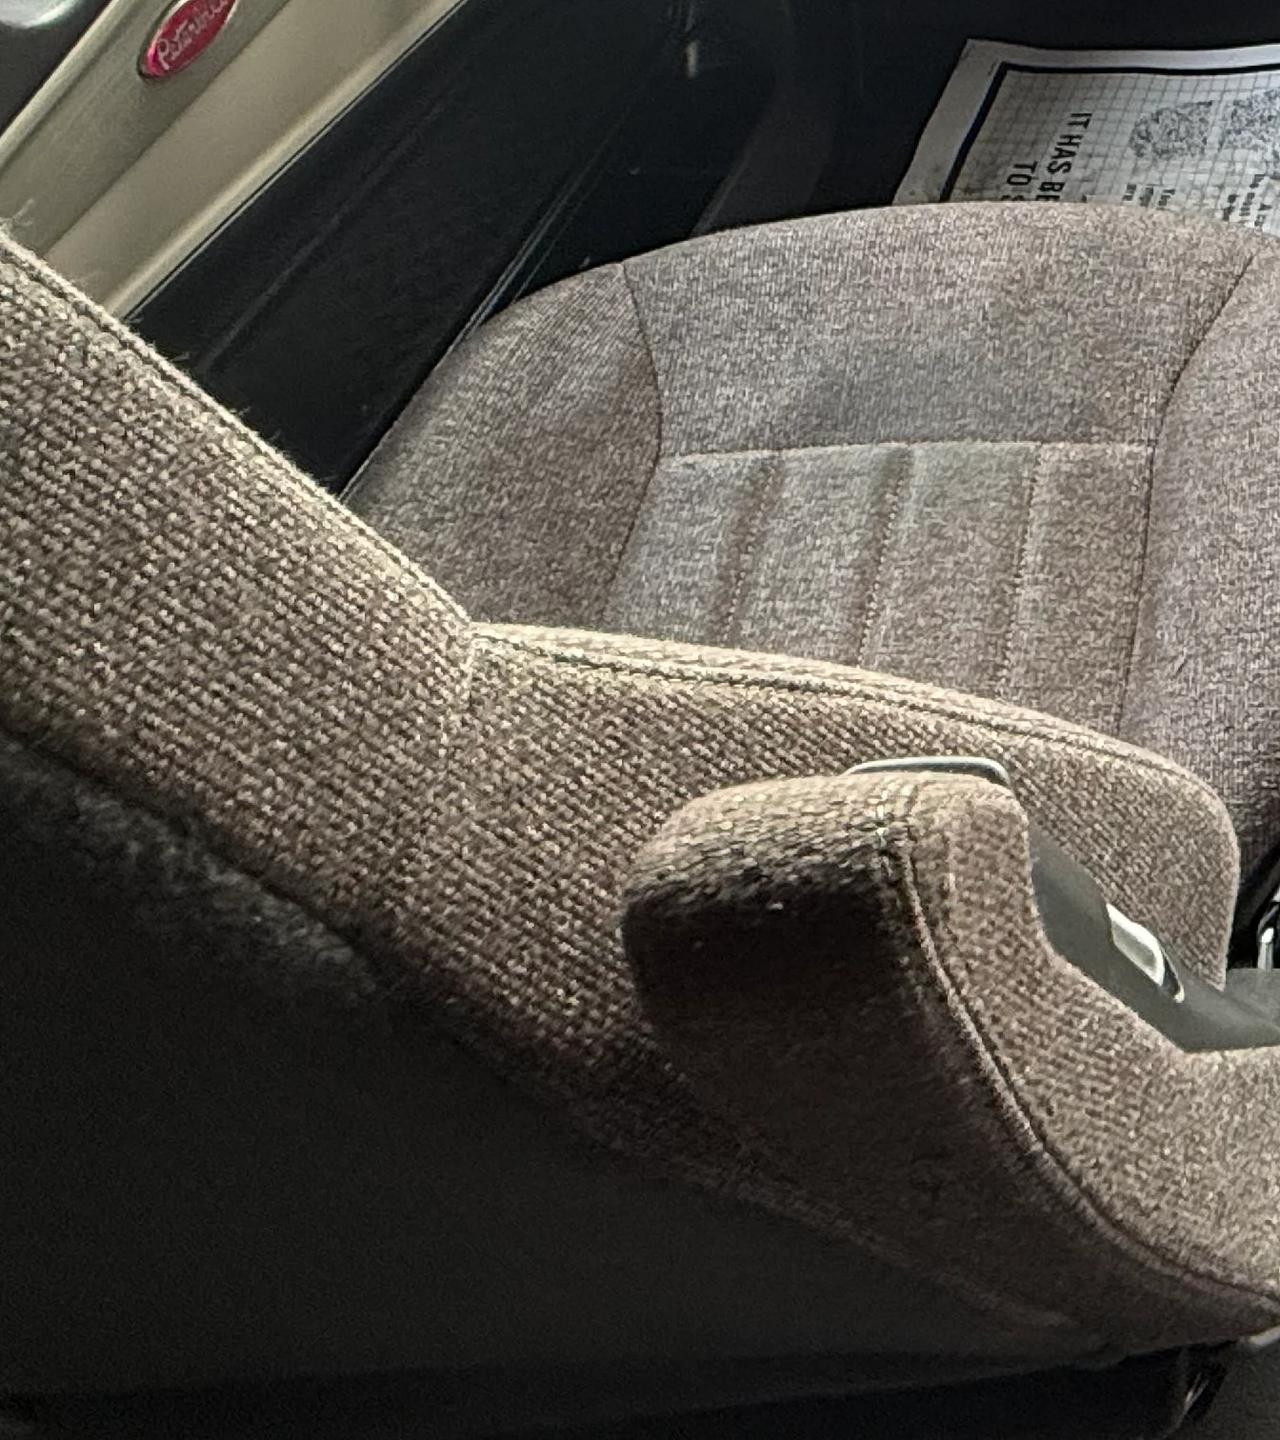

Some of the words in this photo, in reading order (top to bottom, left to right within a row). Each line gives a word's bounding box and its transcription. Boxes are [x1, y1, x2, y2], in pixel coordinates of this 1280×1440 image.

[1067, 112, 1093, 129] IT
[1046, 134, 1084, 175] HAS
[1006, 160, 1038, 186] TO
